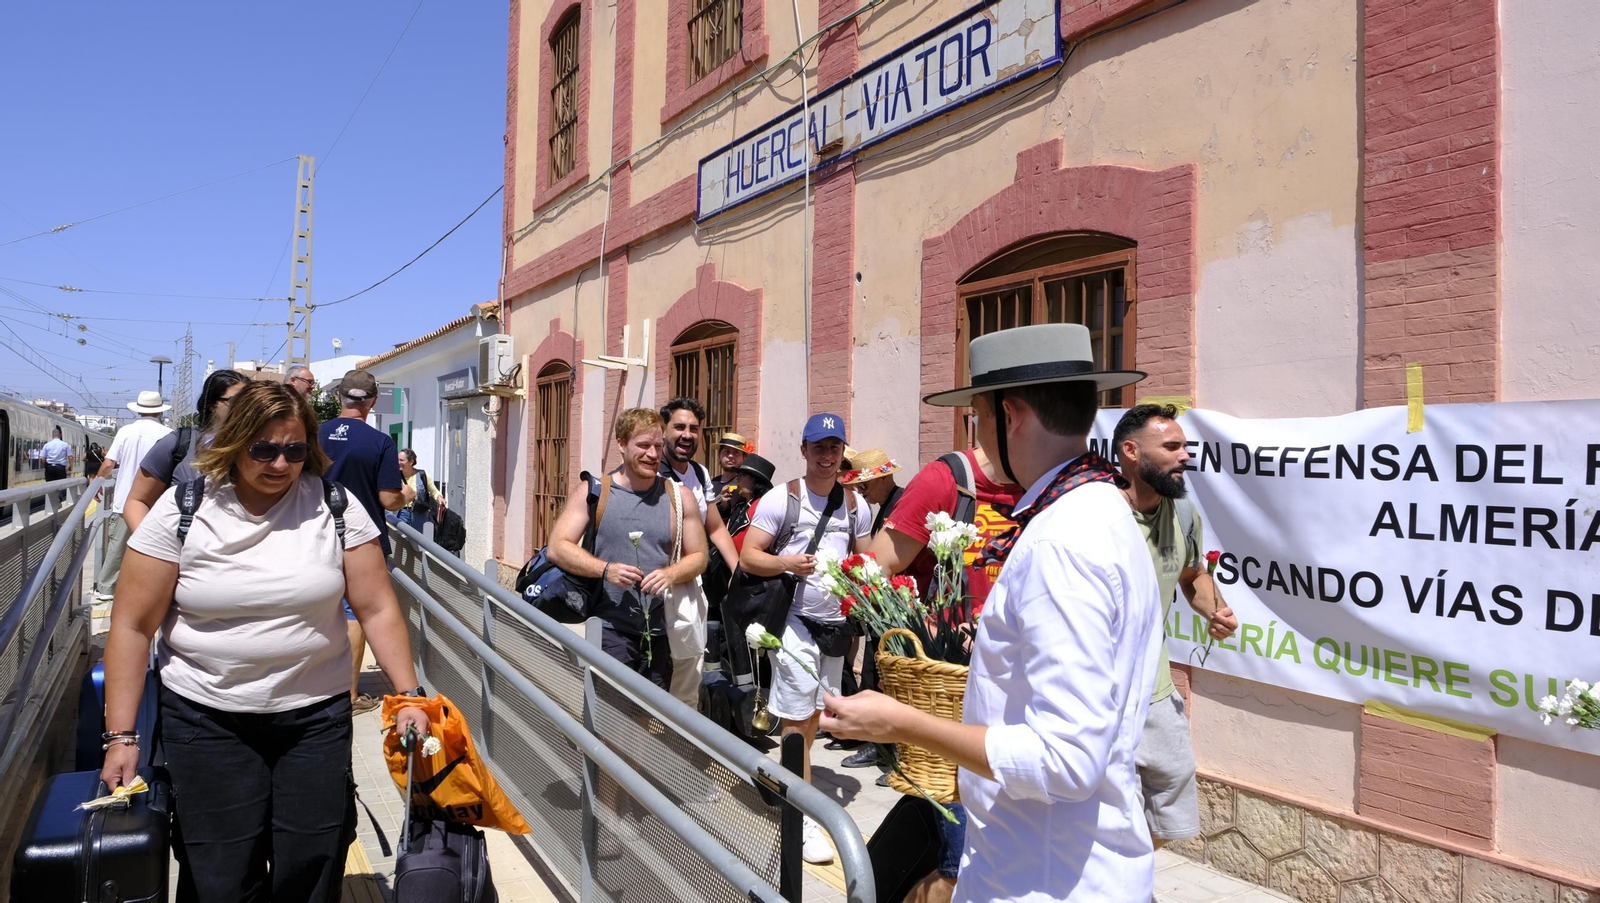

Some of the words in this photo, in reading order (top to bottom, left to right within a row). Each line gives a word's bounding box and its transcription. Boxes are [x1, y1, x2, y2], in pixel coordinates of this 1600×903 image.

[822, 417, 835, 429] NY
[1231, 442, 1440, 482] DEFENSA
[1455, 444, 1564, 485] DEL
[1173, 551, 1384, 609] SCANDO
[1400, 569, 1523, 626] VÍAS
[1313, 637, 1474, 700] QUIERE
